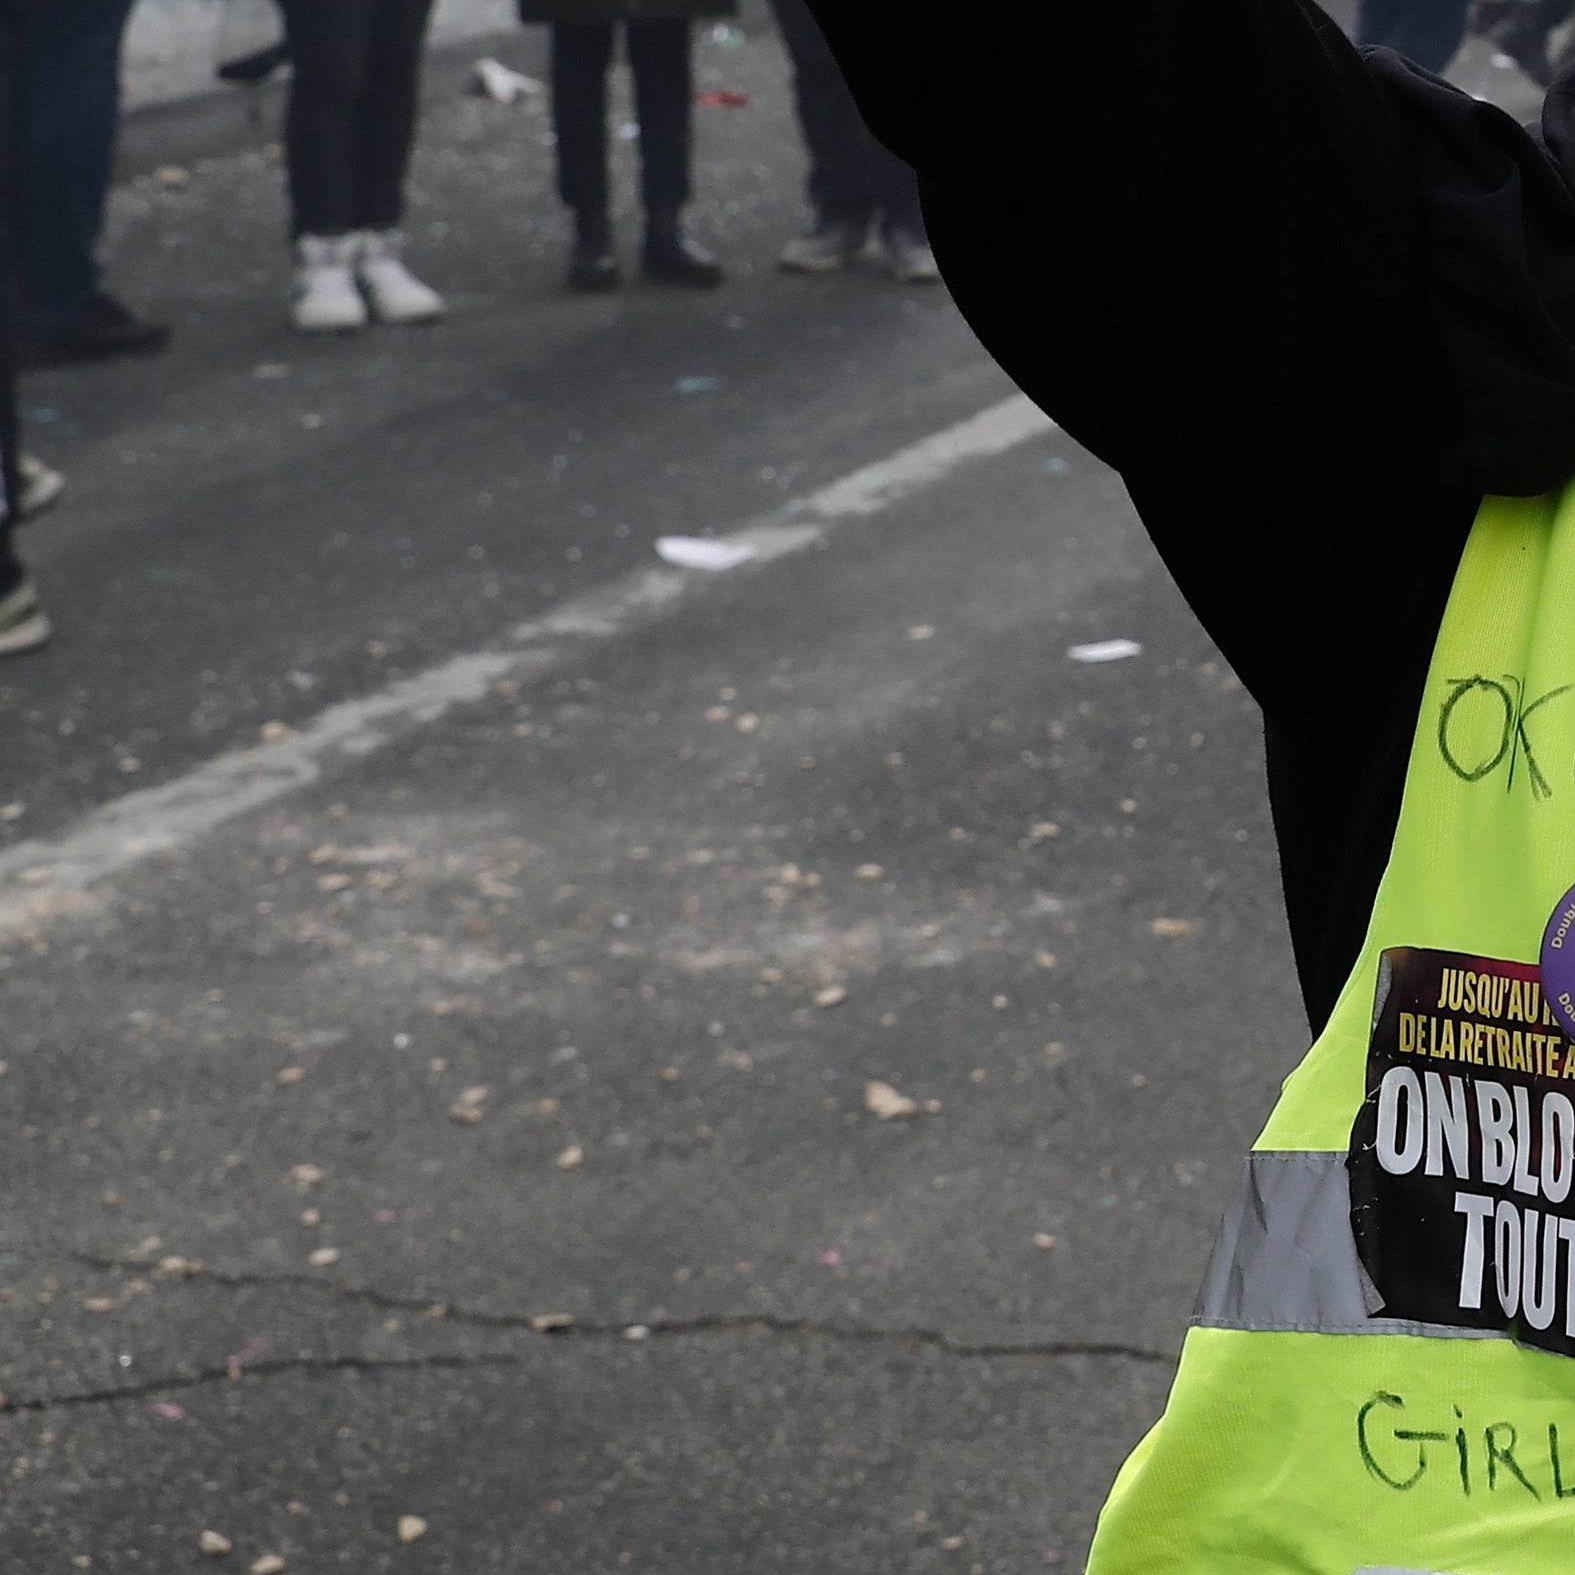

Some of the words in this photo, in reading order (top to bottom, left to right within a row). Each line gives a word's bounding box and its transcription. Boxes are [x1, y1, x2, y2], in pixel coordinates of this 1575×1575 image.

[1399, 1012, 1427, 1056] DE
[1430, 1016, 1457, 1061] LA
[1459, 1022, 1562, 1079] RETRAITE
[1375, 1065, 1470, 1179] ON
